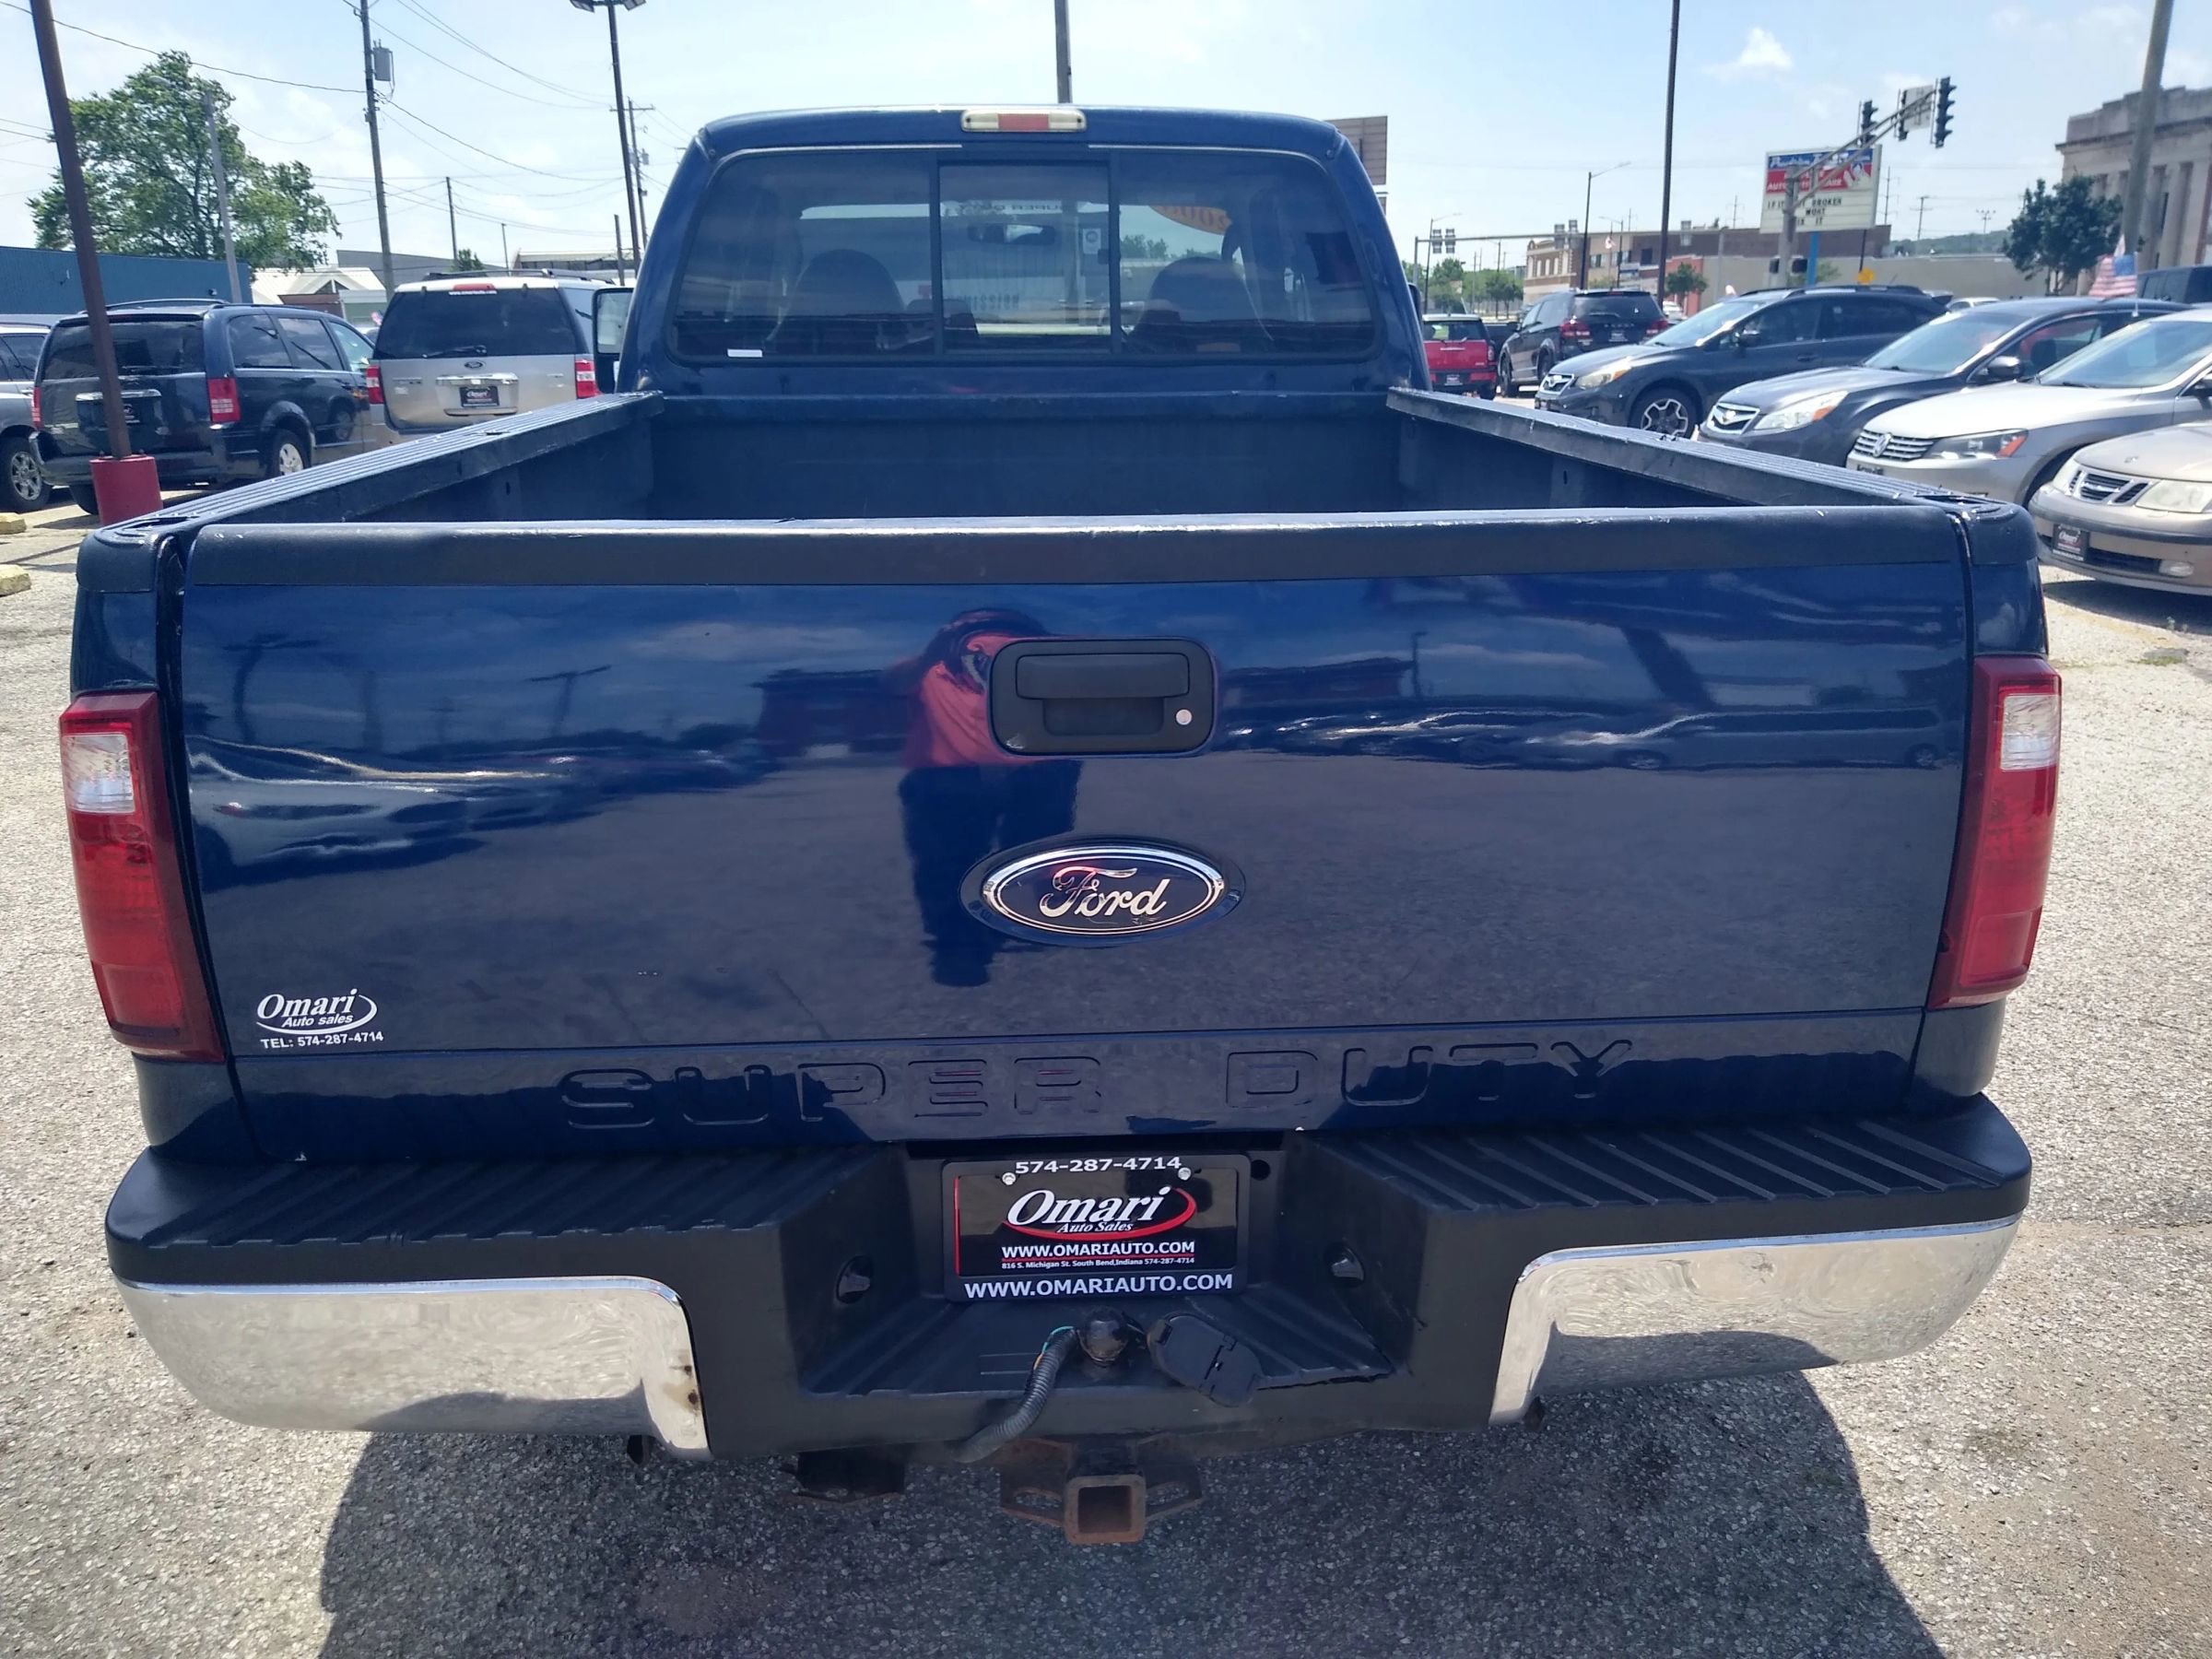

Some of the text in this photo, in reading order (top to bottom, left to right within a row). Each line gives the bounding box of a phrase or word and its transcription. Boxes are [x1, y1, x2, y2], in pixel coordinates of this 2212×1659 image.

[1040, 865, 1171, 918] Ford
[257, 988, 358, 1019] Omari
[282, 1016, 314, 1028] Auto
[261, 1031, 383, 1049] TEL: 574-287-4714
[559, 1039, 1632, 1128] SUPER DUTY
[1015, 1157, 1182, 1173] 574-287-4714
[1007, 1185, 1171, 1226] Omari
[1056, 1221, 1134, 1233] Auto Sales
[1002, 1241, 1194, 1258] WWW.OMARIAUTO.COM
[1026, 1261, 1060, 1269] Michigan
[964, 1274, 1233, 1299] WWW.OMARIAUTO.COM
